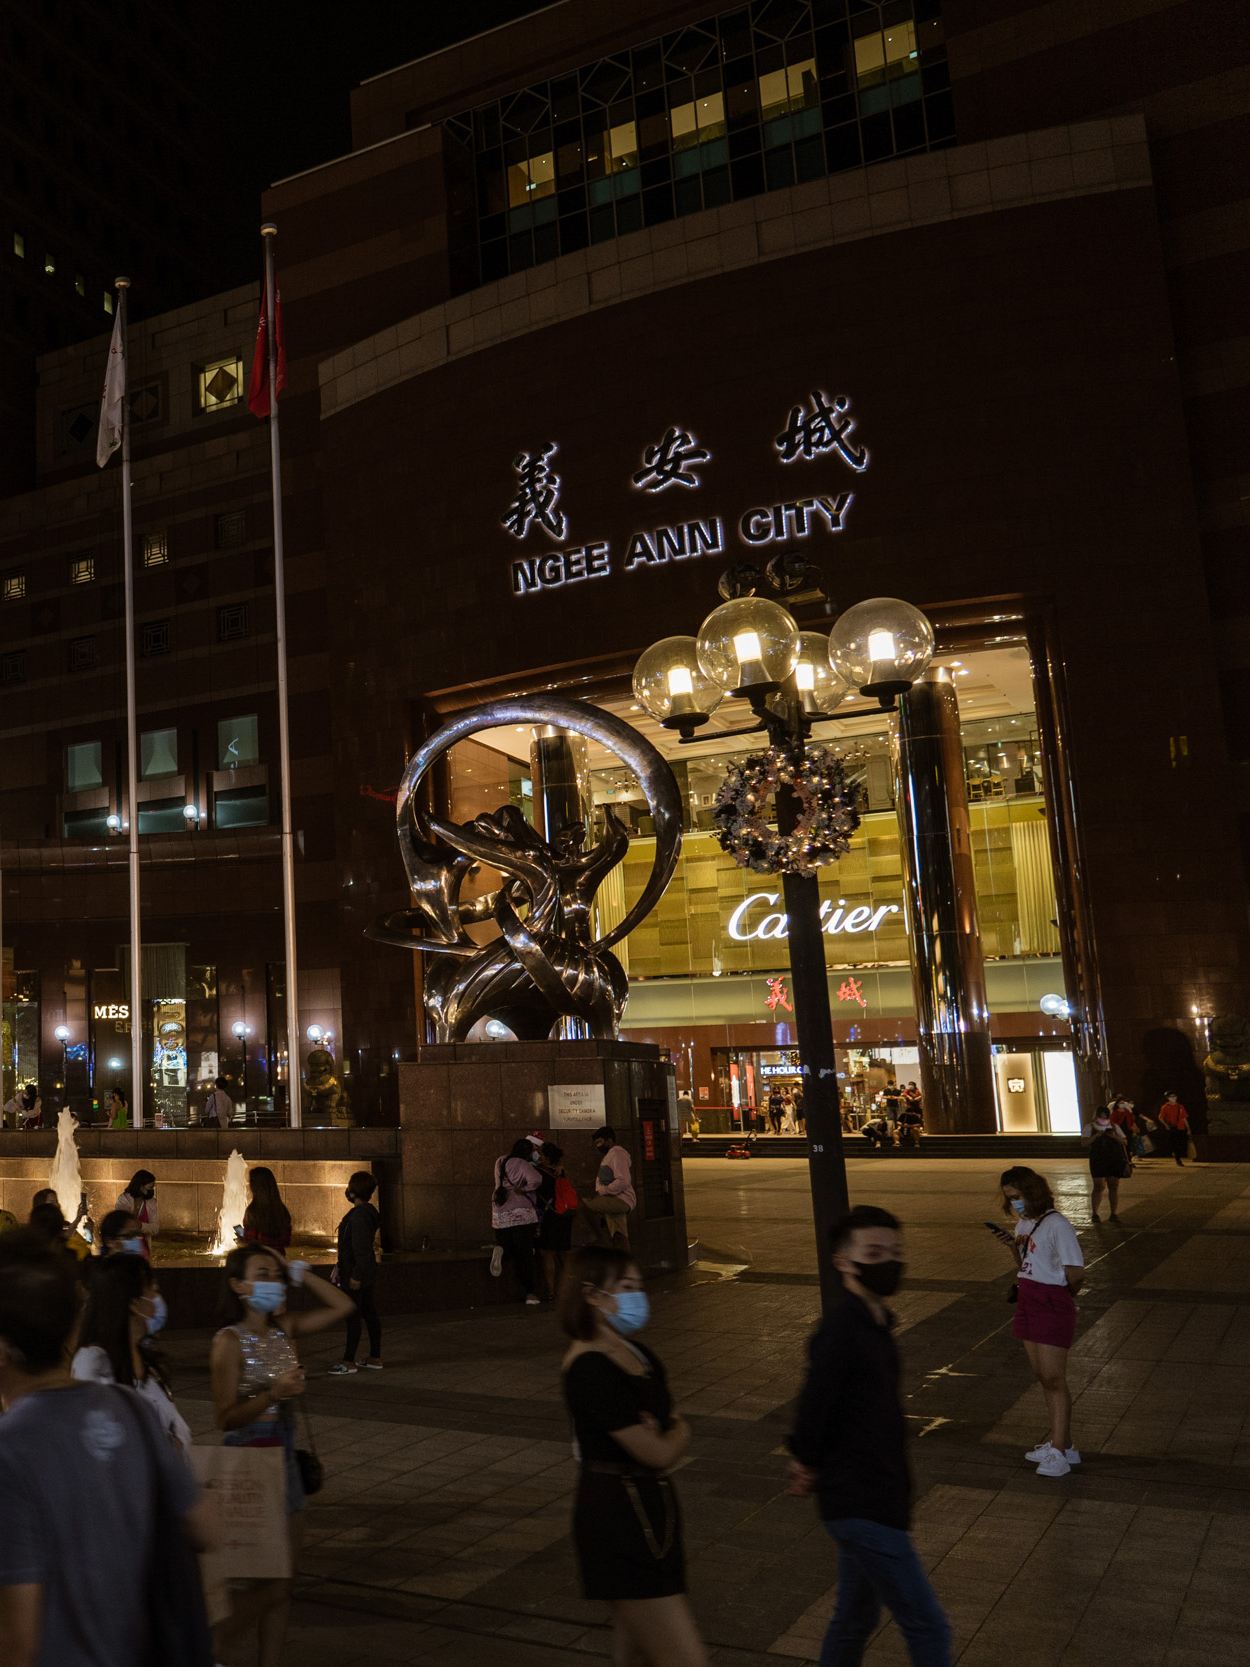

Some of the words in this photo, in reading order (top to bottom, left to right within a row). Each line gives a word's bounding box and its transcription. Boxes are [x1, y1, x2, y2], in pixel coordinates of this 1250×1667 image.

[511, 542, 610, 593] NGEE
[624, 518, 722, 569] ANN
[740, 493, 854, 545] CITY
[727, 893, 899, 940] Catier
[772, 1066, 797, 1075] HOUR
[812, 1144, 824, 1152] 38
